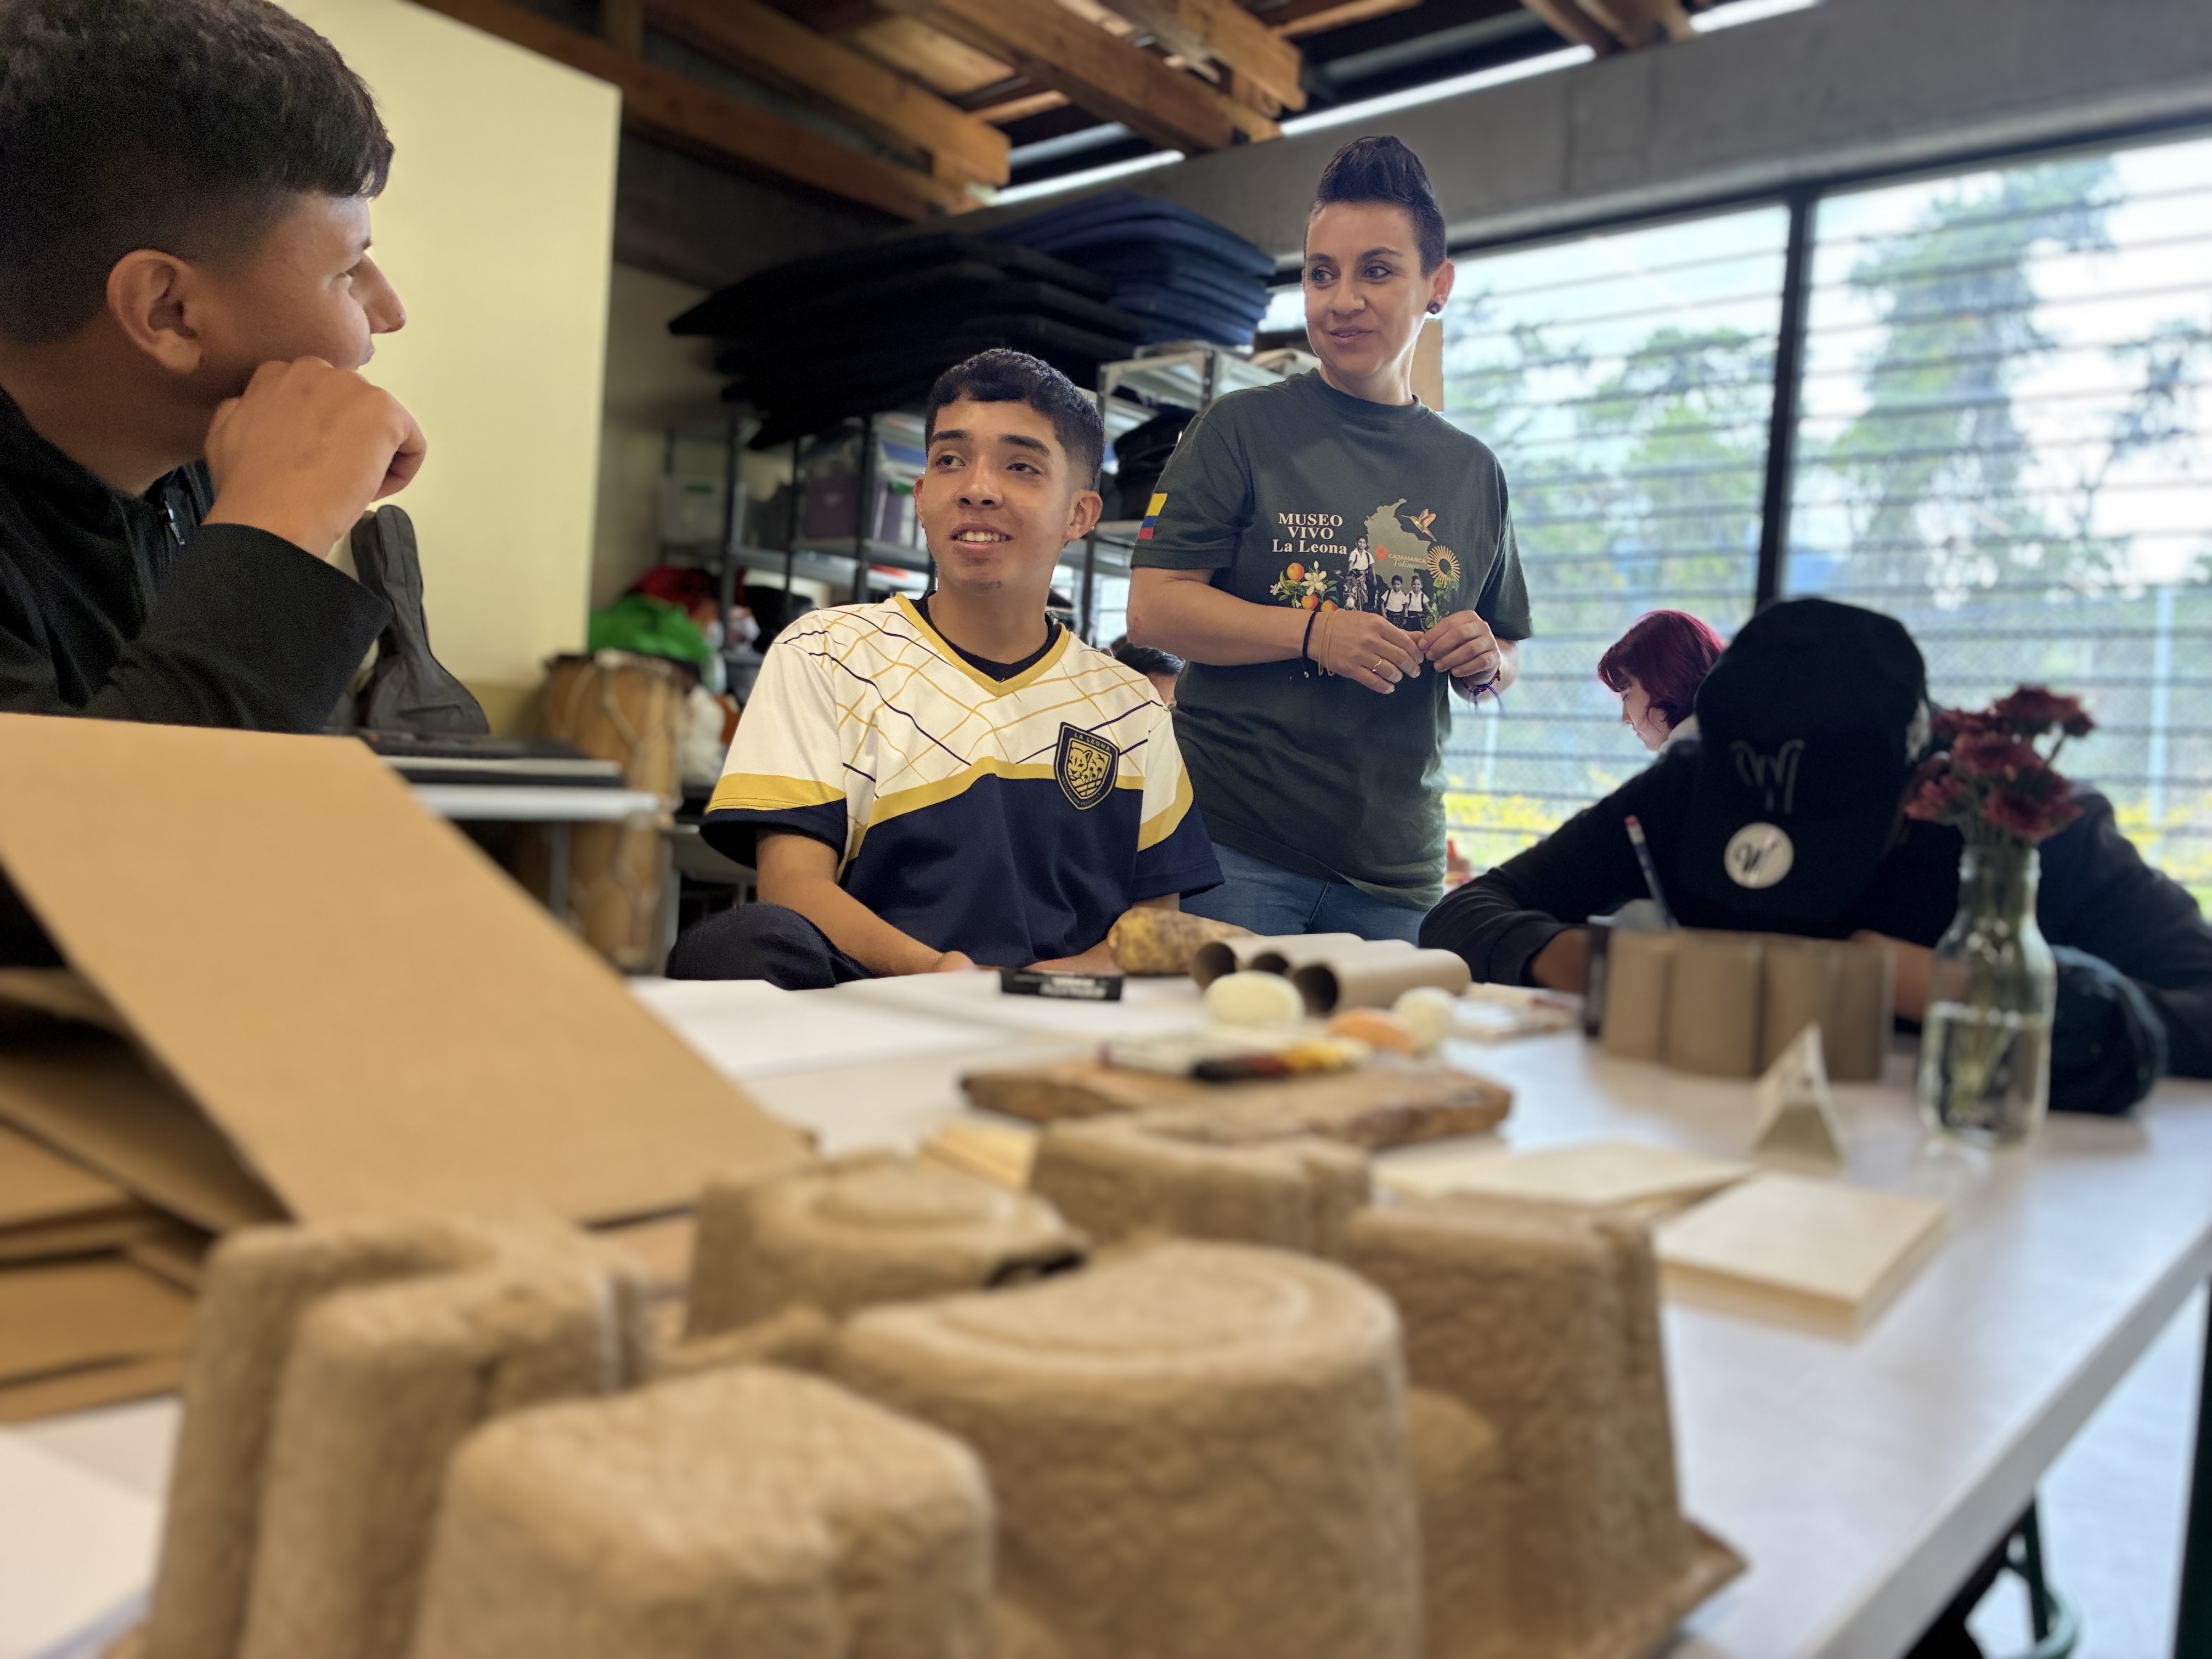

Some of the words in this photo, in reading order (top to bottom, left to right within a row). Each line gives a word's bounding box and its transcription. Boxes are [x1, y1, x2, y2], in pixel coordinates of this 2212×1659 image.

[1278, 512, 1343, 527] MUSEO
[1288, 526, 1334, 539] VIVO
[1272, 539, 1293, 552] La
[1298, 540, 1347, 555] Leona
[1388, 553, 1426, 564] CAJAMARCA
[1393, 560, 1419, 569] Tolima
[1087, 737, 1110, 752] LEONA
